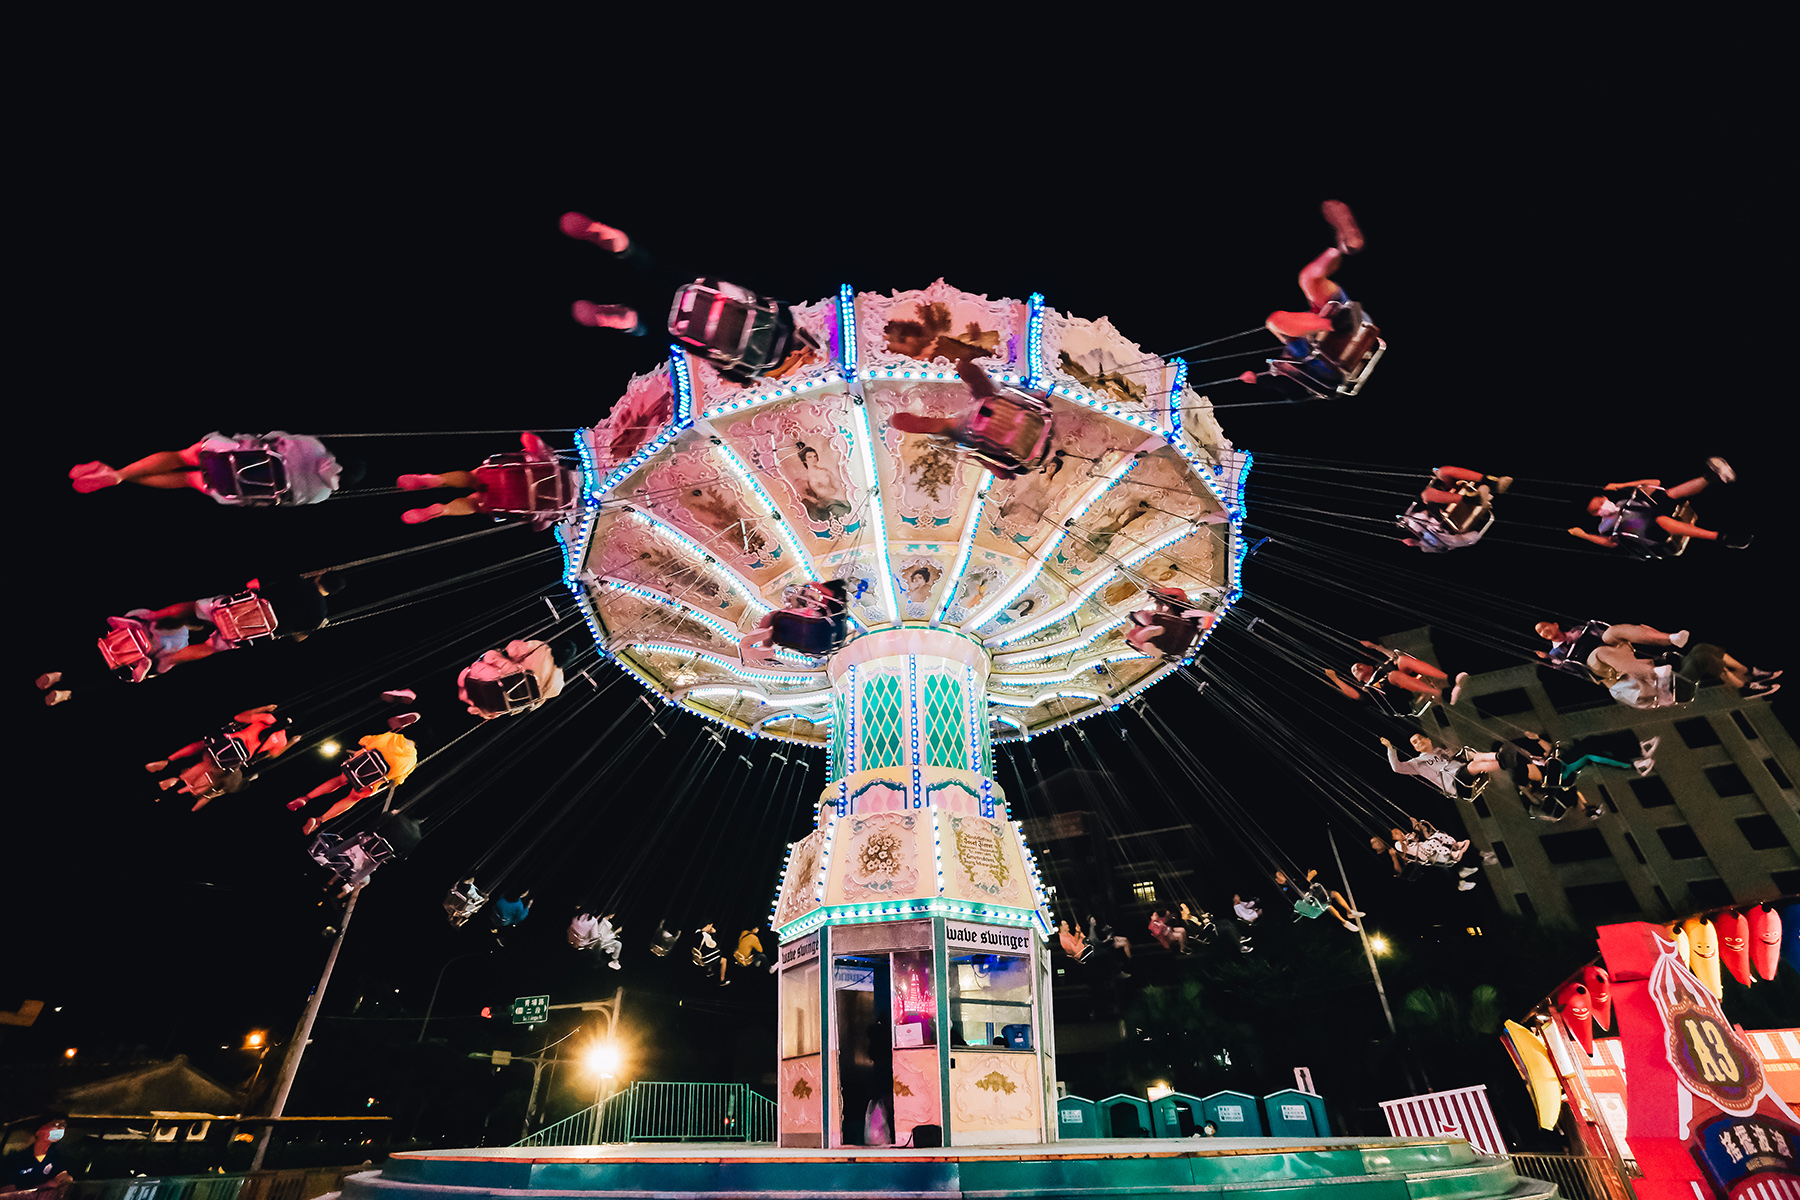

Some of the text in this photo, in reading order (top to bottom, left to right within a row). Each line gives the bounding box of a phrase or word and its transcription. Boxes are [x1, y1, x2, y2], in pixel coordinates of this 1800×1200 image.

[946, 925, 1030, 950] wave swinger
[1684, 1019, 1740, 1083] A3
